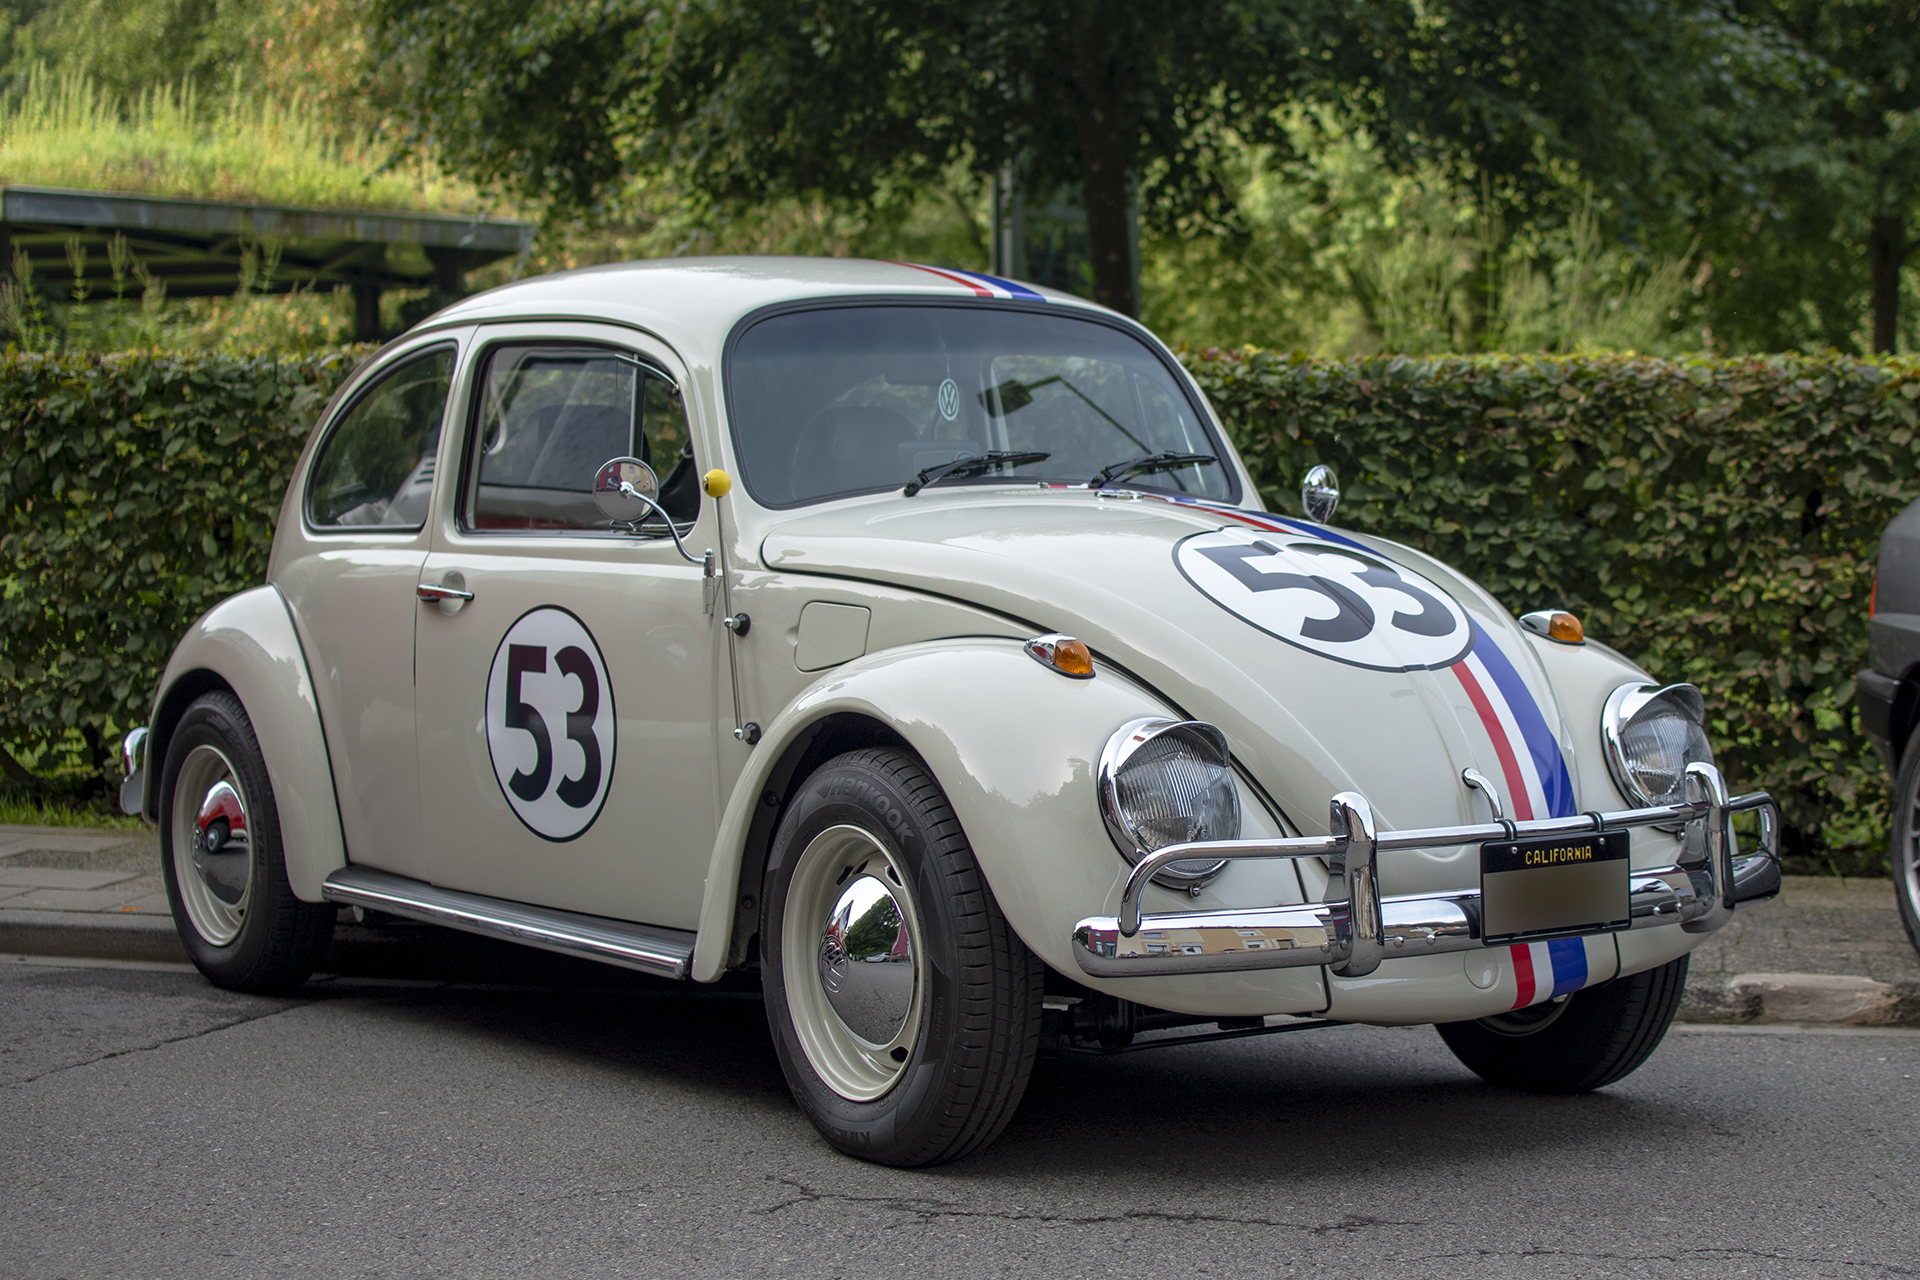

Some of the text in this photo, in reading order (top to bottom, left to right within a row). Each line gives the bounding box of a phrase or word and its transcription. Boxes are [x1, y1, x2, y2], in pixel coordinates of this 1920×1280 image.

[1193, 540, 1457, 643] 53
[505, 643, 602, 809] 53
[1525, 846, 1592, 865] CALIFORNIA
